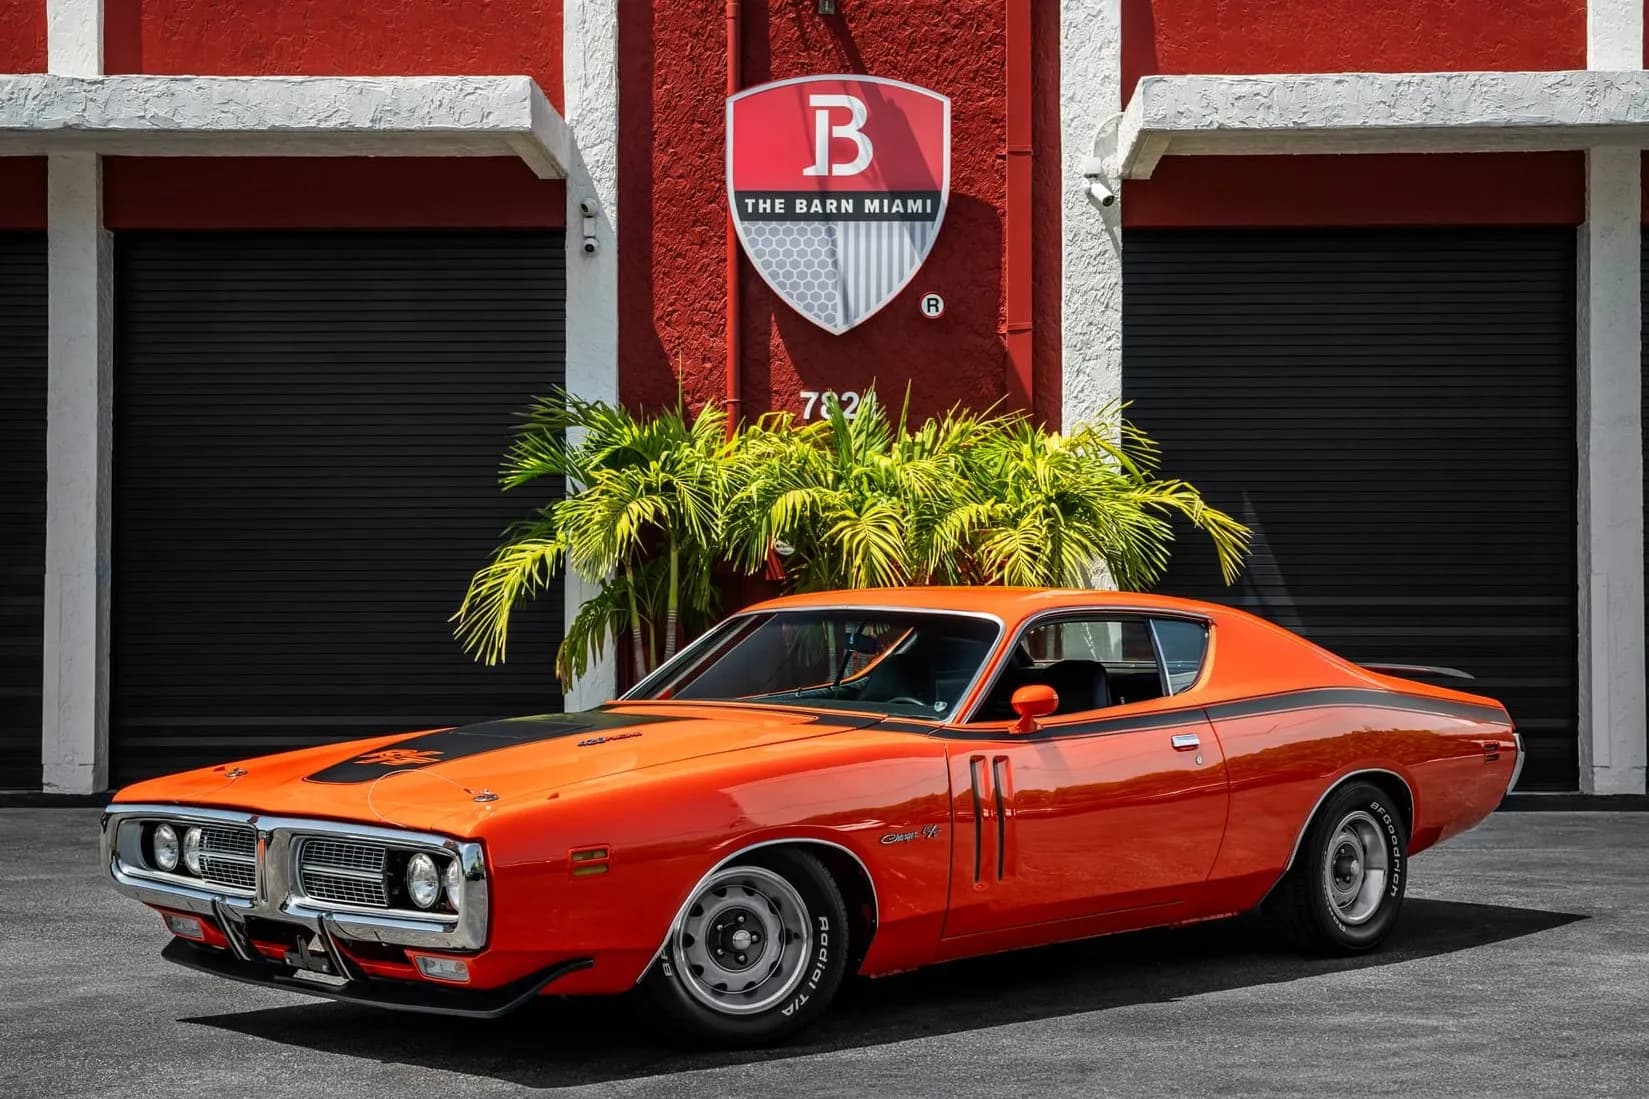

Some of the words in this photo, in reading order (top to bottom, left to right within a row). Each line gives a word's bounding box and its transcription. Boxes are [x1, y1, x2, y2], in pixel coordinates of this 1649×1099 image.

[803, 94, 874, 176] B
[744, 199, 785, 214] THE
[795, 199, 854, 214] BARN
[864, 199, 932, 214] MIAMI
[1370, 801, 1401, 897] BFGoodrich
[808, 915, 829, 990] Radial
[781, 994, 810, 1017] T/A
